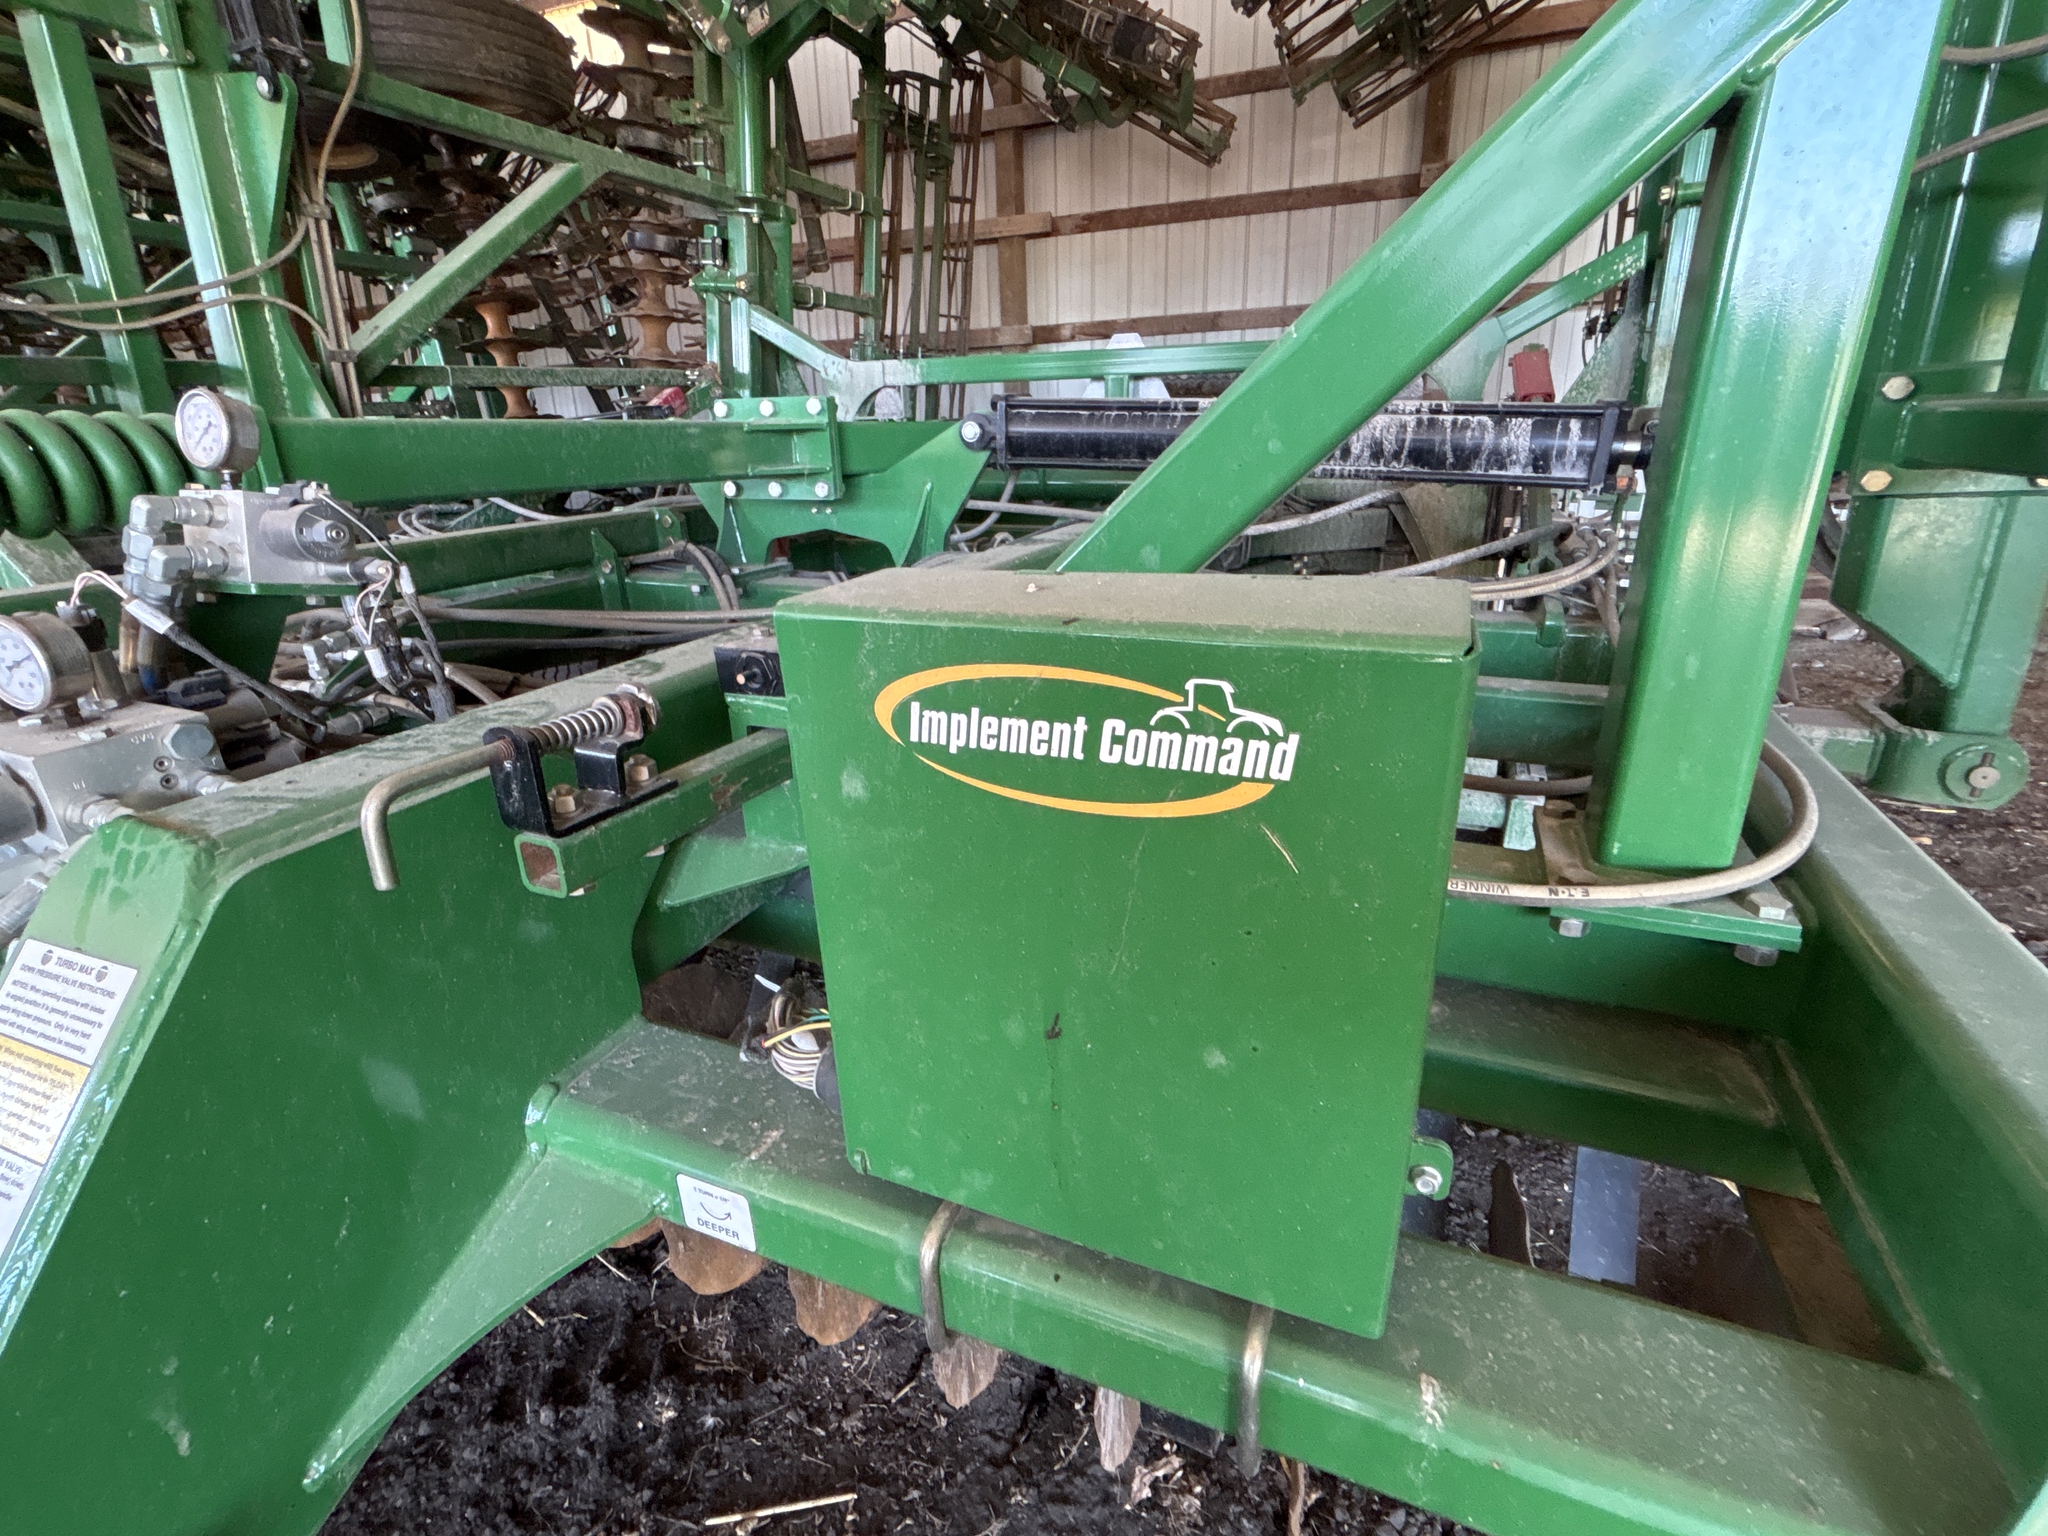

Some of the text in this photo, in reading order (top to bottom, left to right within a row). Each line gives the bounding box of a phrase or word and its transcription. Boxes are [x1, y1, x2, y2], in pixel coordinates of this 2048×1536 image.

[909, 701, 1300, 782] Implement Command
[1450, 880, 1511, 895] WINNER
[54, 956, 96, 976] TURBO MAX
[61, 976, 79, 988] VALVE
[697, 1217, 740, 1241] DEEPER
